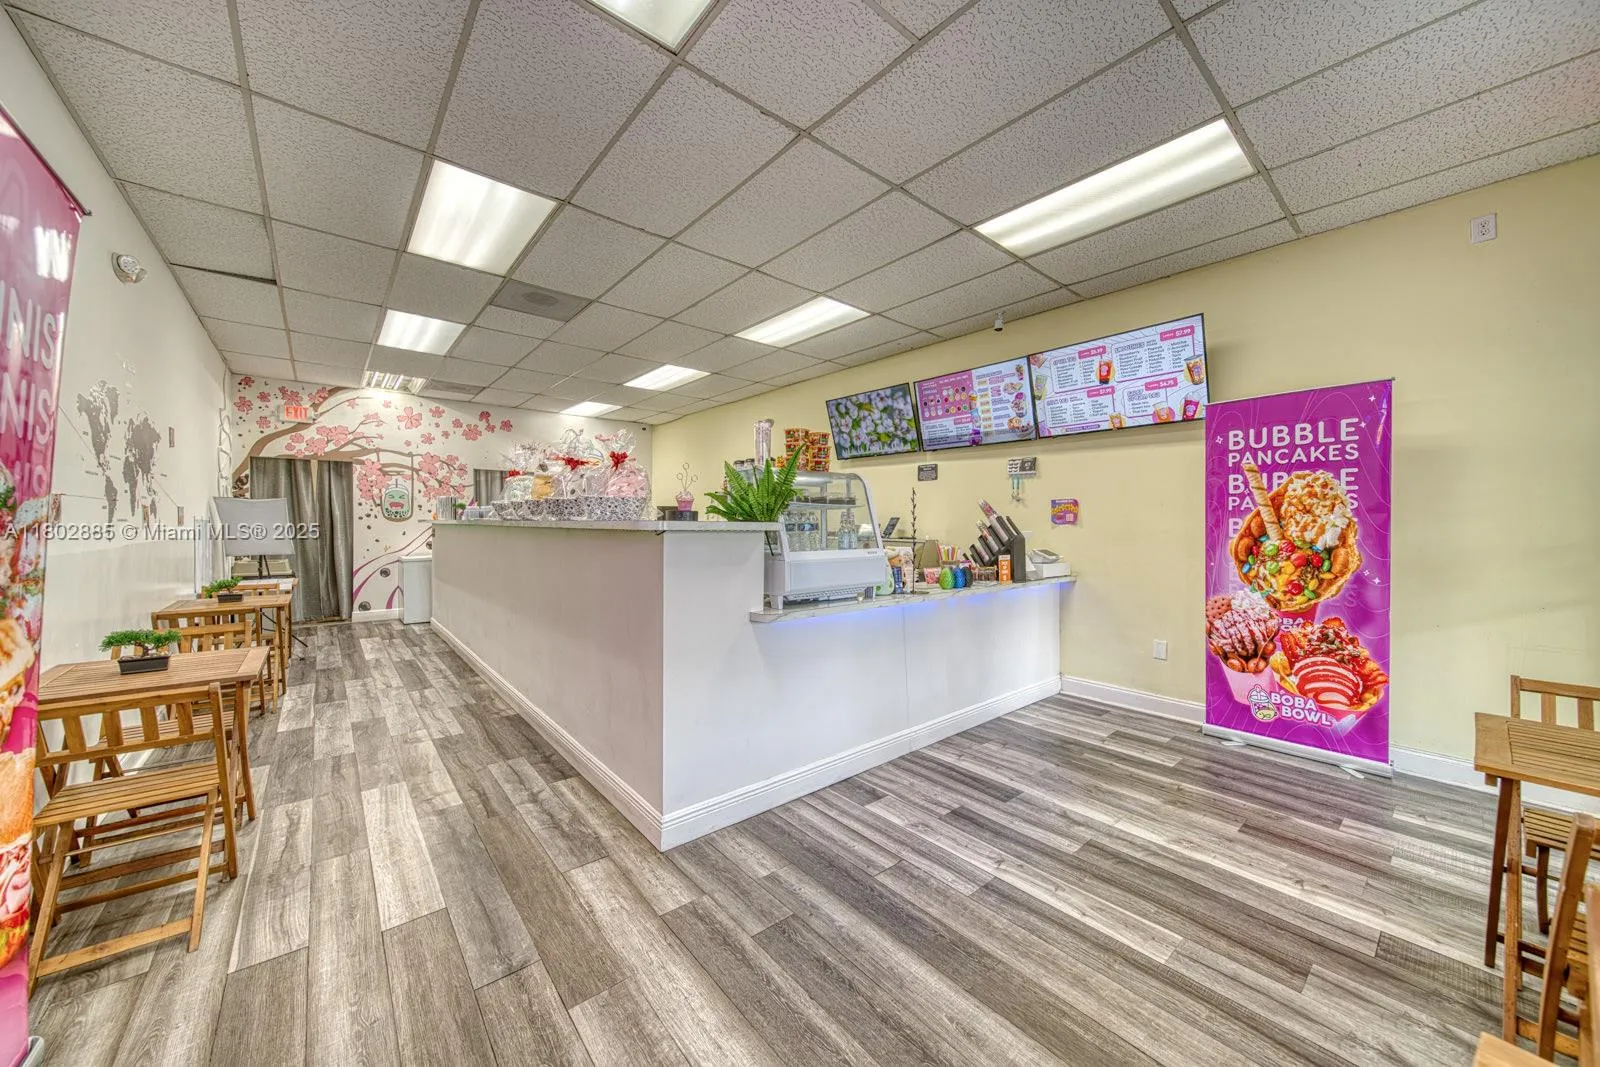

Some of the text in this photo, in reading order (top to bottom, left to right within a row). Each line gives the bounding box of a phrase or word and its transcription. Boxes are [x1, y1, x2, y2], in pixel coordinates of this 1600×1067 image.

[285, 404, 309, 420] EXIT
[1228, 417, 1360, 451] BUBBLE
[1228, 443, 1360, 467] PANCAKES
[1228, 467, 1359, 495] BBE
[1270, 692, 1317, 711] BOBA
[1281, 705, 1332, 726] BOWL
